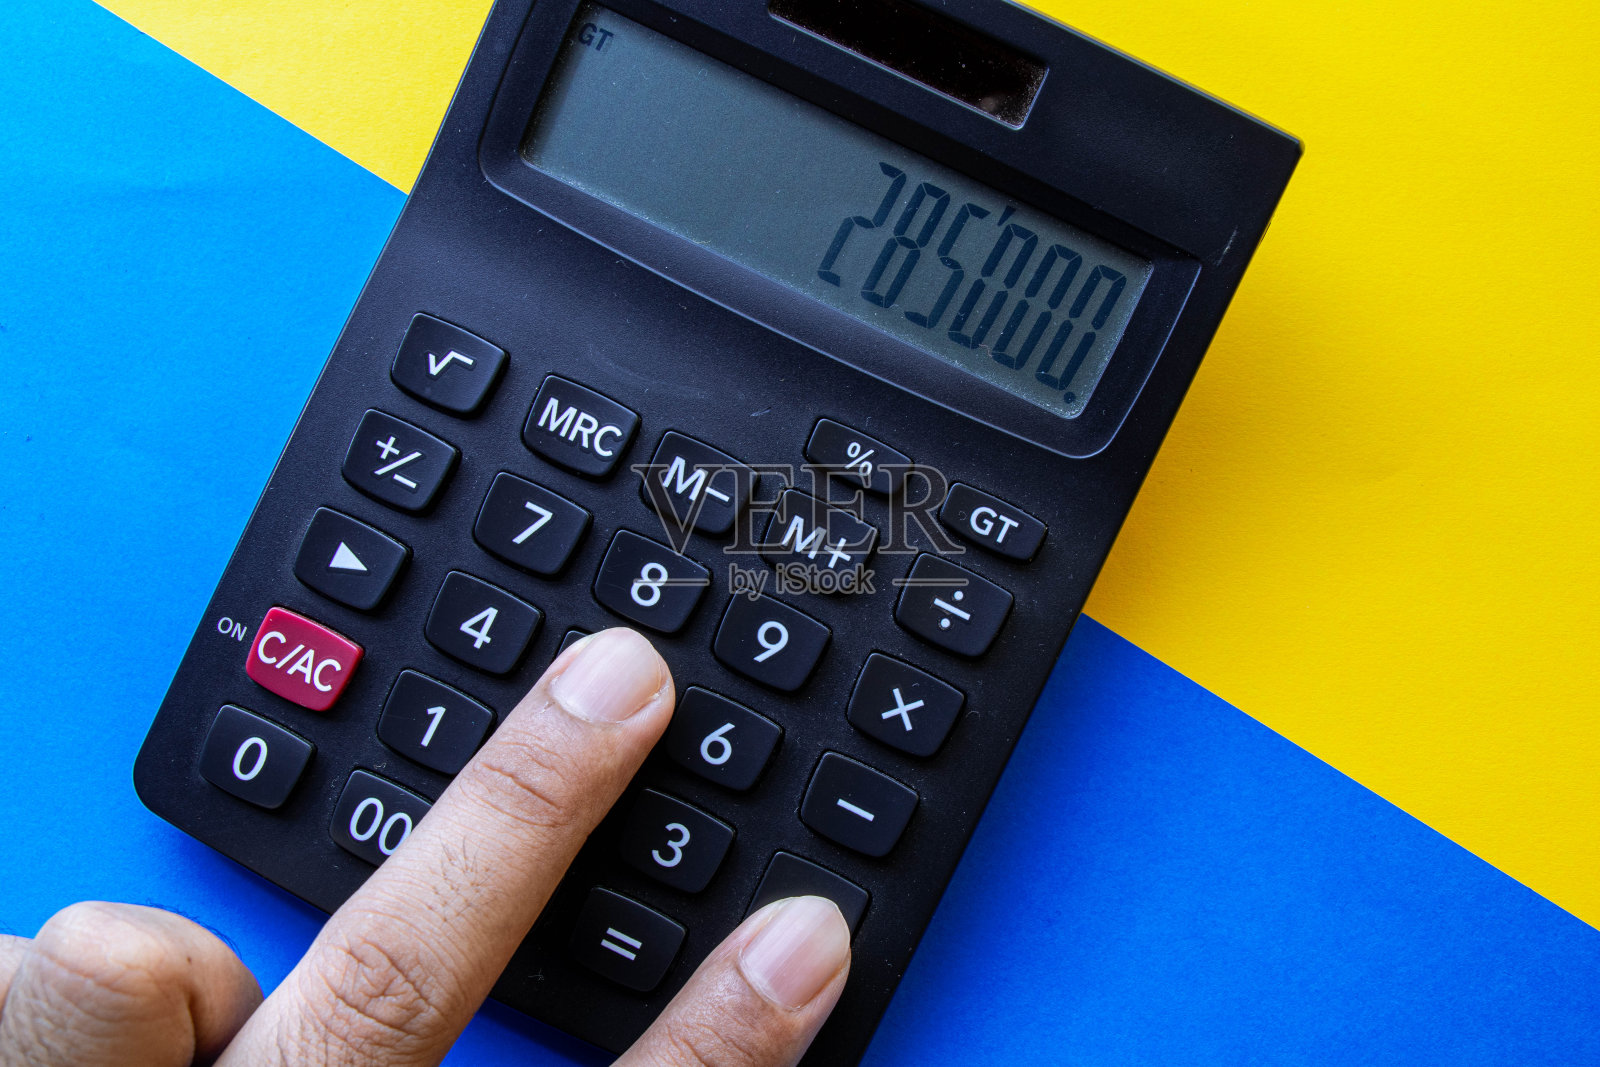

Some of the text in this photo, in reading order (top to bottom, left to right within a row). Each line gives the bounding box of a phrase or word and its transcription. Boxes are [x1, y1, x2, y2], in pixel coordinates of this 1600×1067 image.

[537, 397, 622, 457] MRC
[512, 502, 553, 544] 7
[969, 506, 1019, 545] GT
[630, 562, 669, 607] 8
[217, 617, 247, 642] ON
[460, 606, 499, 649] 4
[753, 620, 790, 662] 9
[257, 631, 342, 693] C/AC
[420, 706, 447, 747] 1
[700, 722, 737, 765] 6
[232, 737, 268, 781] 0
[349, 797, 413, 856] 00
[651, 822, 691, 868] 3
